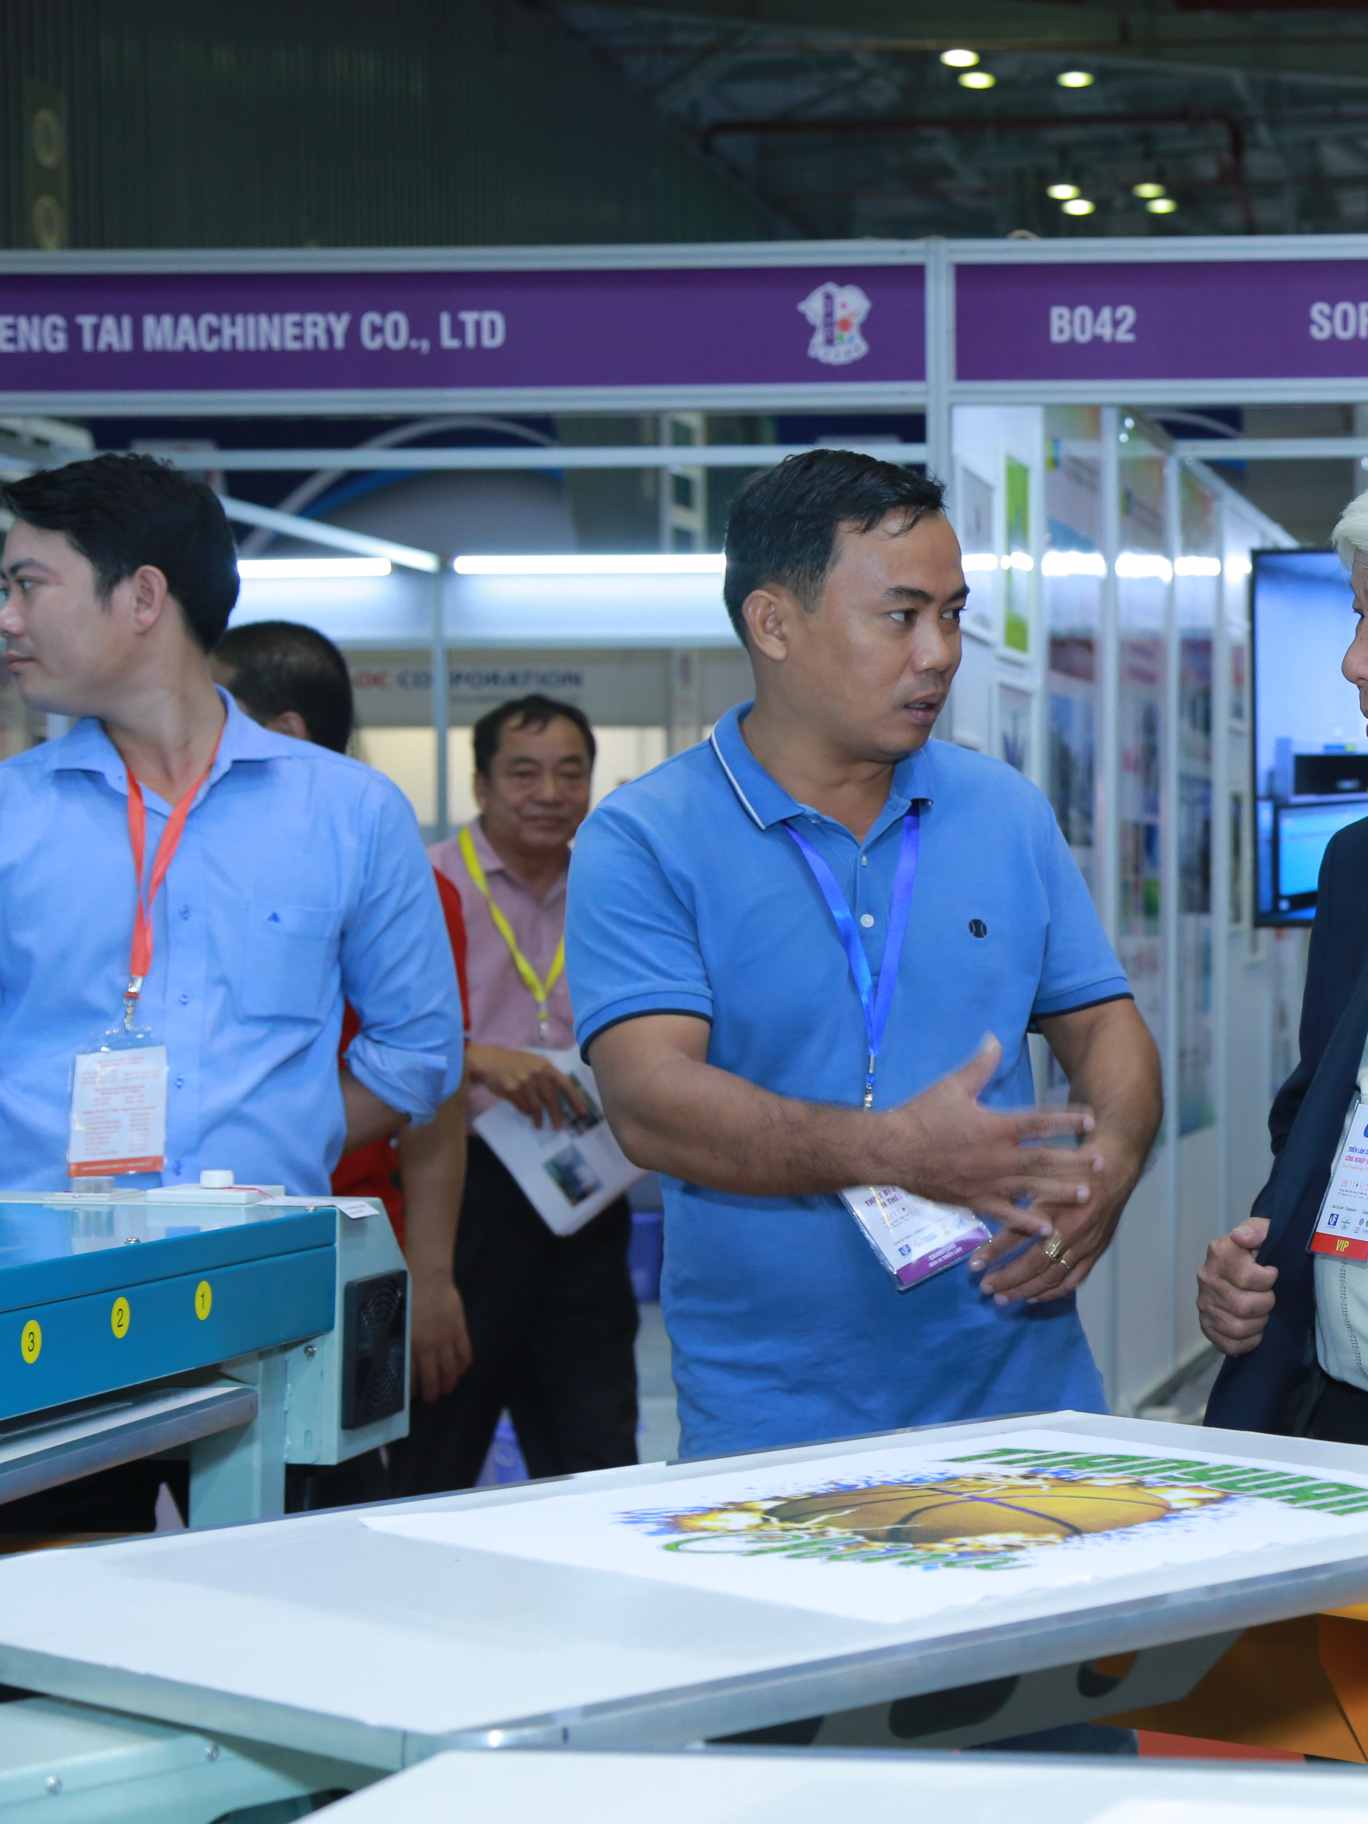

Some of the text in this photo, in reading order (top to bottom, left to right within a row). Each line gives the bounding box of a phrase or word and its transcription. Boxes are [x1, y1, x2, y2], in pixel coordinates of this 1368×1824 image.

[0, 310, 506, 353] ENG TAI MACHINERY CO., LTD
[396, 670, 584, 689] COPORATION
[1336, 1239, 1350, 1252] VIP
